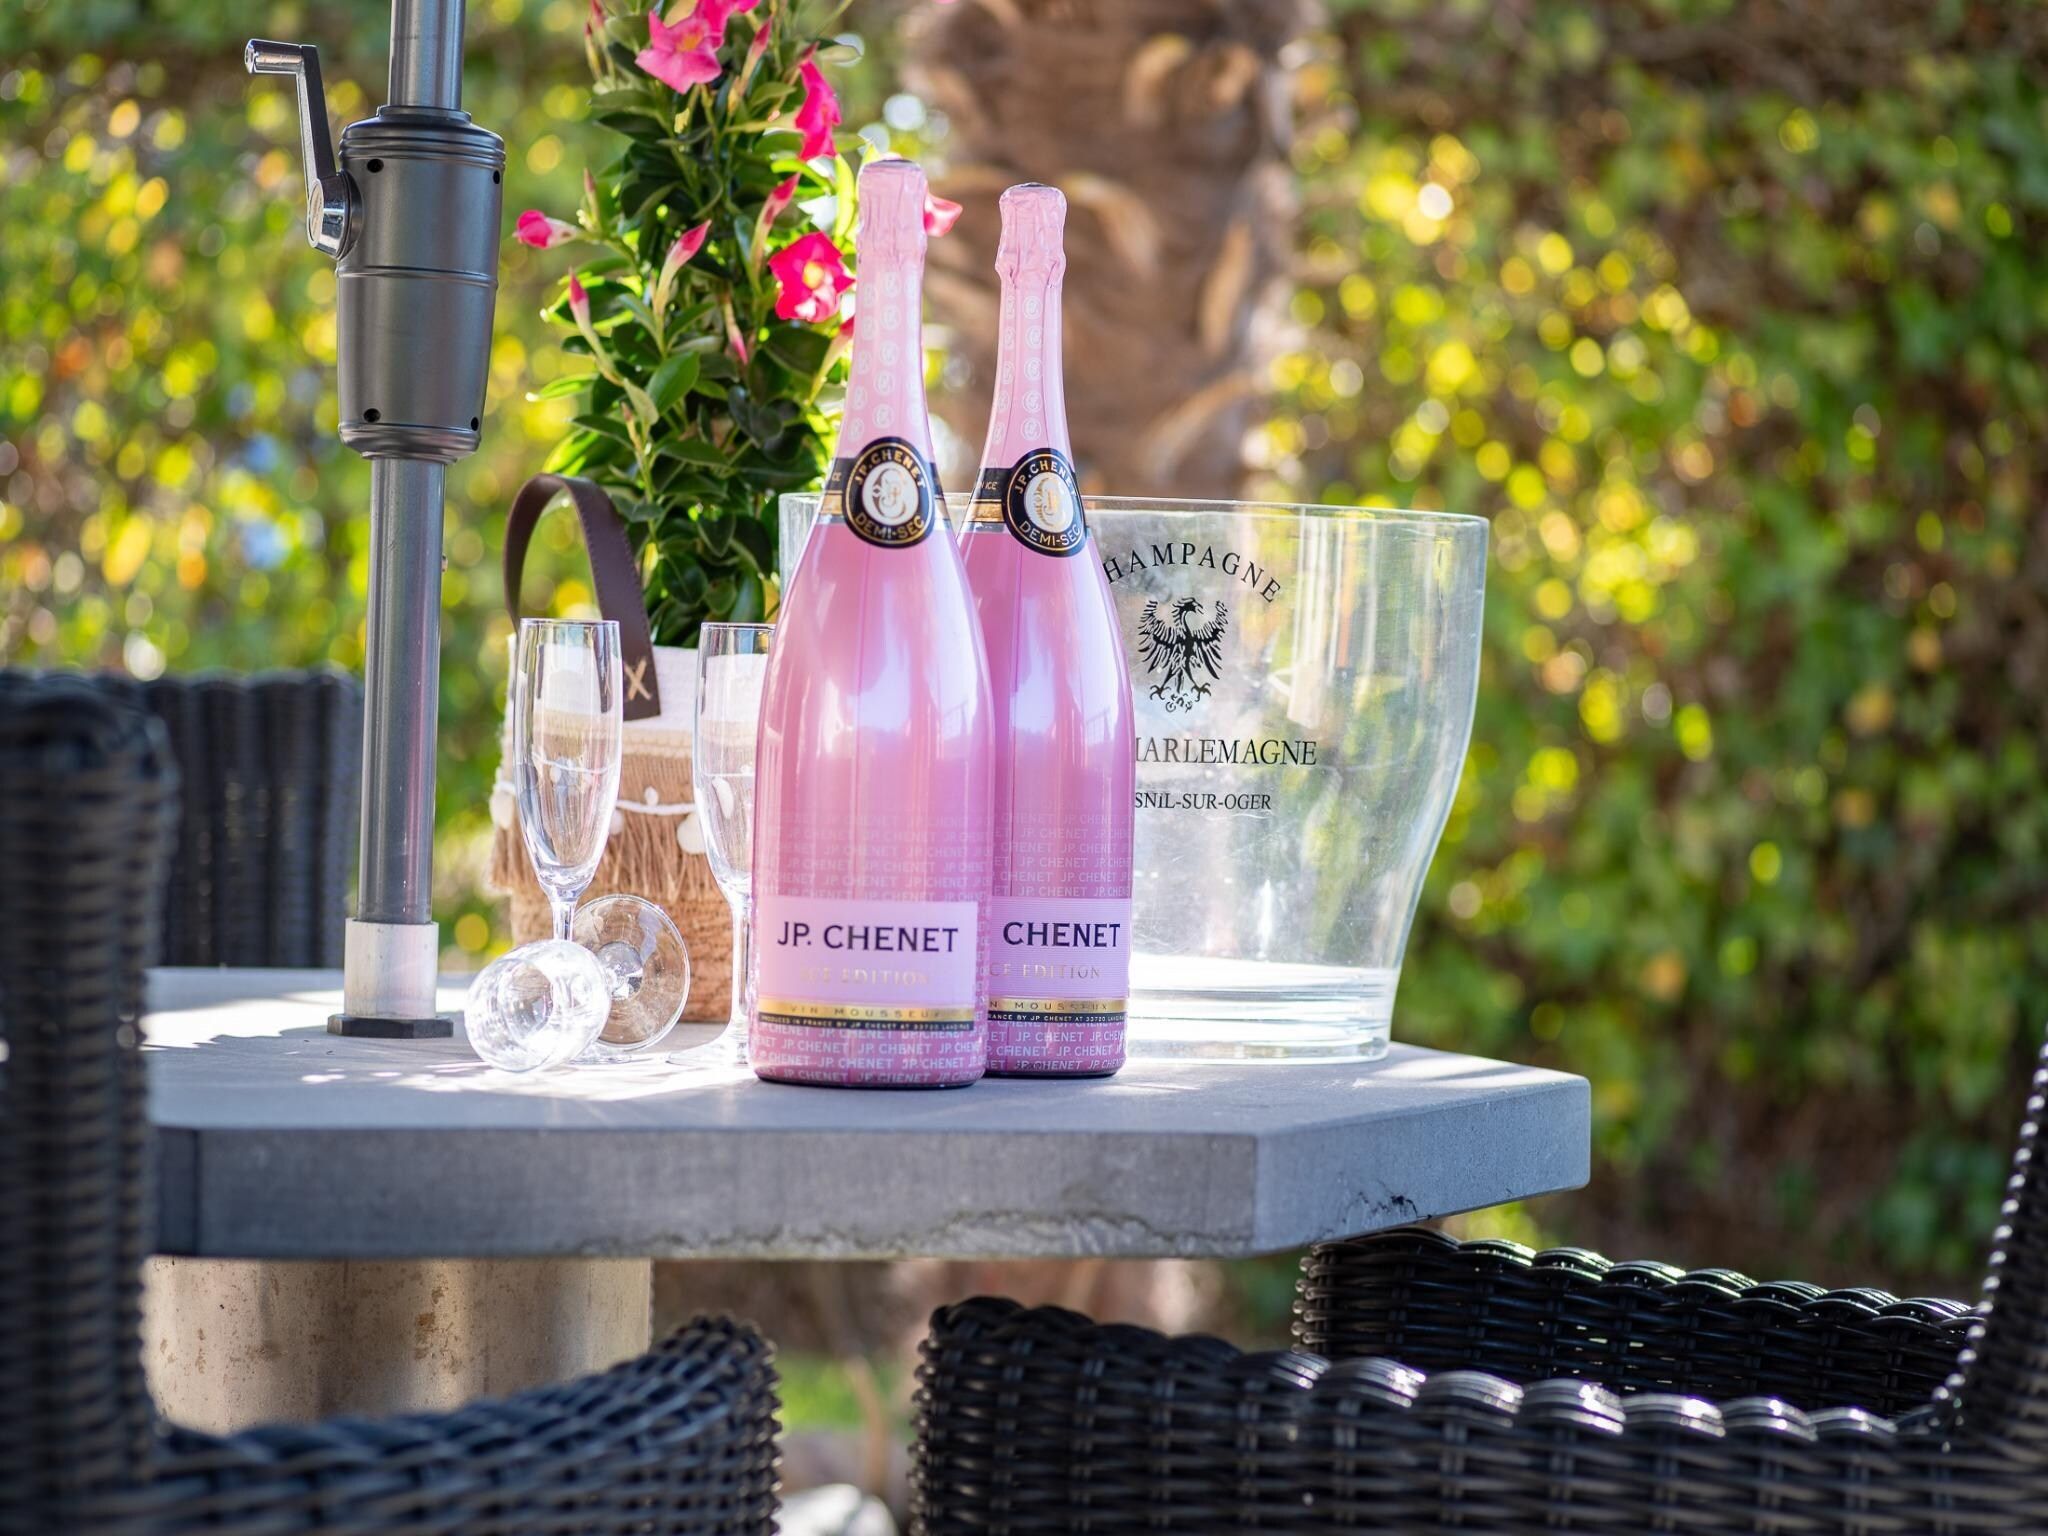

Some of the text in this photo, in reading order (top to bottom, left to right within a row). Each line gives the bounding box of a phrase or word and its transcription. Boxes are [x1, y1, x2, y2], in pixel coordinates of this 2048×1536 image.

[854, 512, 925, 541] DEMI-SEC
[1020, 520, 1081, 547] DEMI-SEC
[1102, 542, 1281, 603] HAMPAGNE
[1135, 737, 1317, 765] ARLEMAGNE
[1135, 791, 1272, 810] SNIL-SUR-OGER
[1039, 857, 1089, 868] CHENET
[1038, 886, 1088, 897] CHENET
[777, 921, 959, 952] JP. CHENET
[1003, 921, 1121, 948] CHENET
[989, 962, 1102, 979] CE EDITION
[791, 1006, 819, 1015] VIN
[1035, 1031, 1084, 1043] CHENET
[797, 1039, 849, 1053] CHENET
[880, 1043, 932, 1055] CHENET
[996, 1045, 1048, 1057] CHENET
[1074, 1045, 1113, 1057] CHENET
[838, 1057, 894, 1069] CHENET
[922, 1057, 965, 1069] CHENET
[1034, 1060, 1084, 1070] CHENET
[797, 1069, 848, 1081] CHENET
